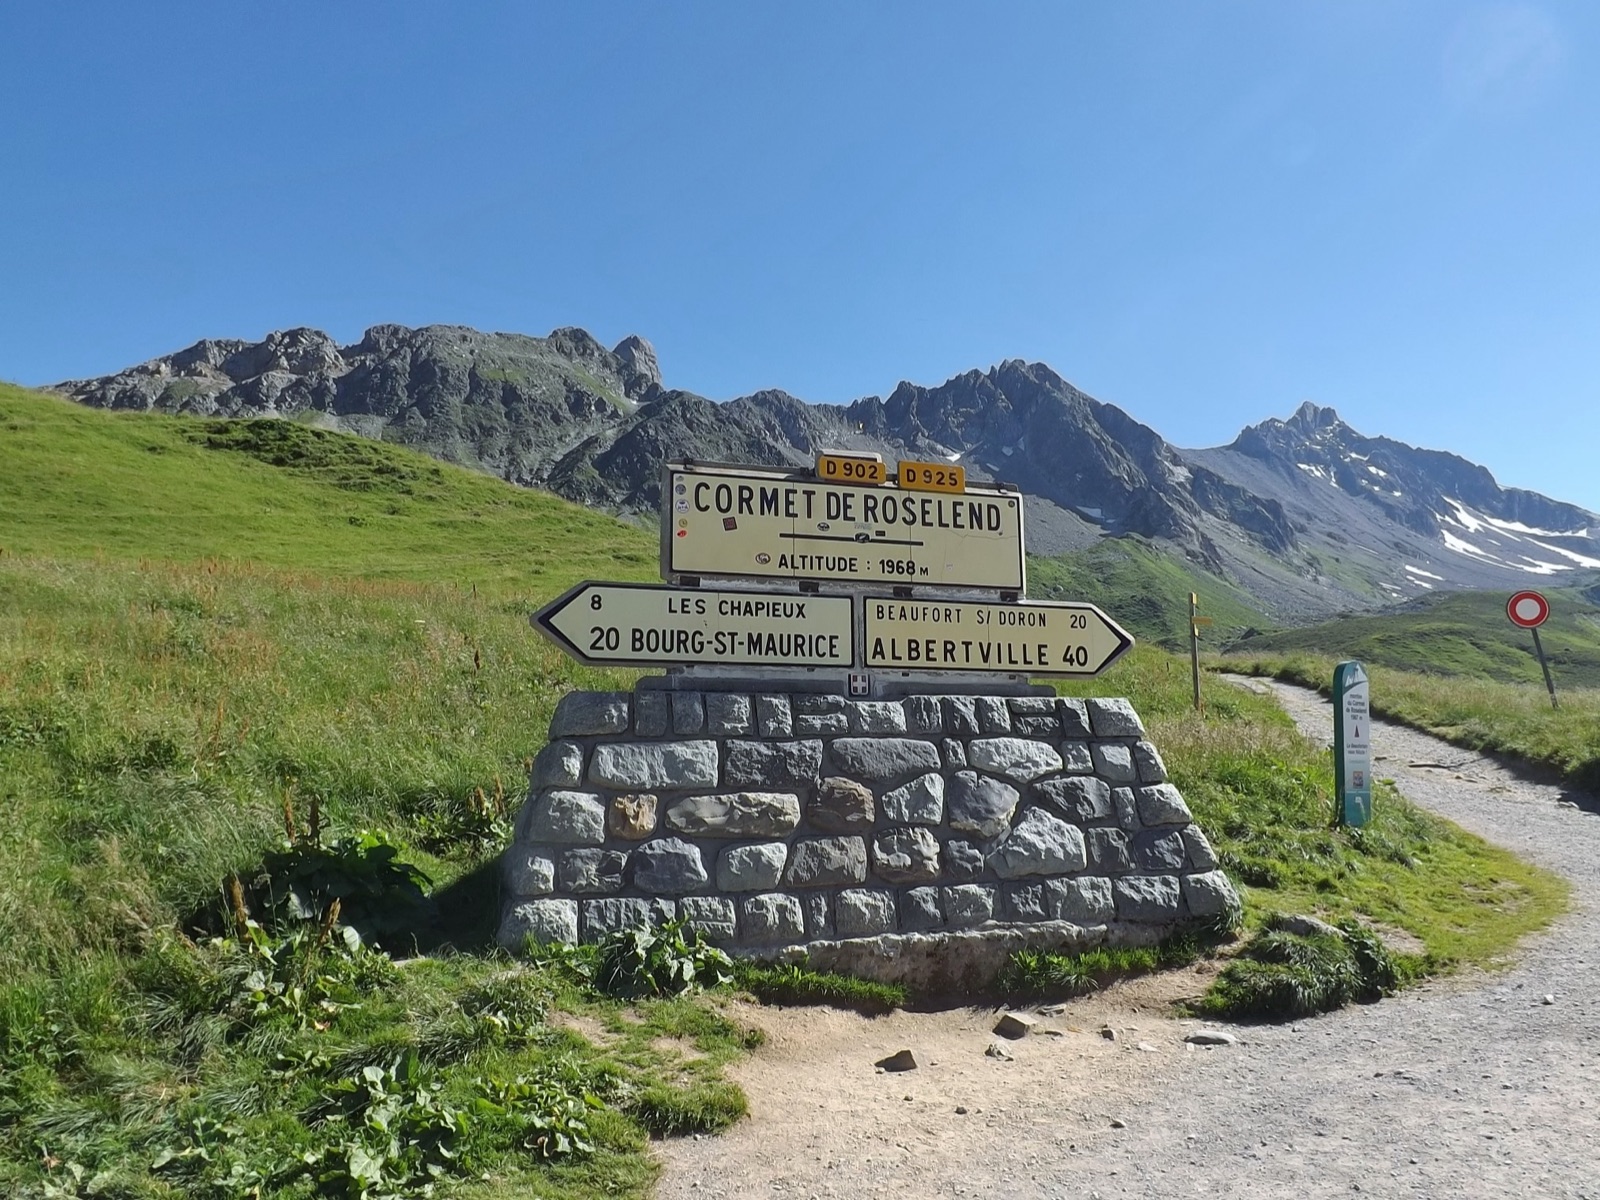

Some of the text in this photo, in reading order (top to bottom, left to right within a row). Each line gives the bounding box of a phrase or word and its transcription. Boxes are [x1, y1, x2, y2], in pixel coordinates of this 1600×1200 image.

[826, 459, 879, 479] D 902
[906, 468, 958, 487] D 925
[694, 482, 816, 519] CORMET
[826, 492, 856, 523] DE
[864, 494, 1001, 532] ROSELEND
[778, 553, 858, 573] ALTITUDE
[879, 559, 916, 576] 1968
[590, 594, 806, 619] 8 LES CHAPIEUX
[876, 604, 962, 624] BEAUFORT
[1070, 614, 1087, 629] 20
[590, 626, 840, 659] 20 BOURG-ST-MAURICE
[872, 637, 1088, 667] ALBERTVILLE 40
